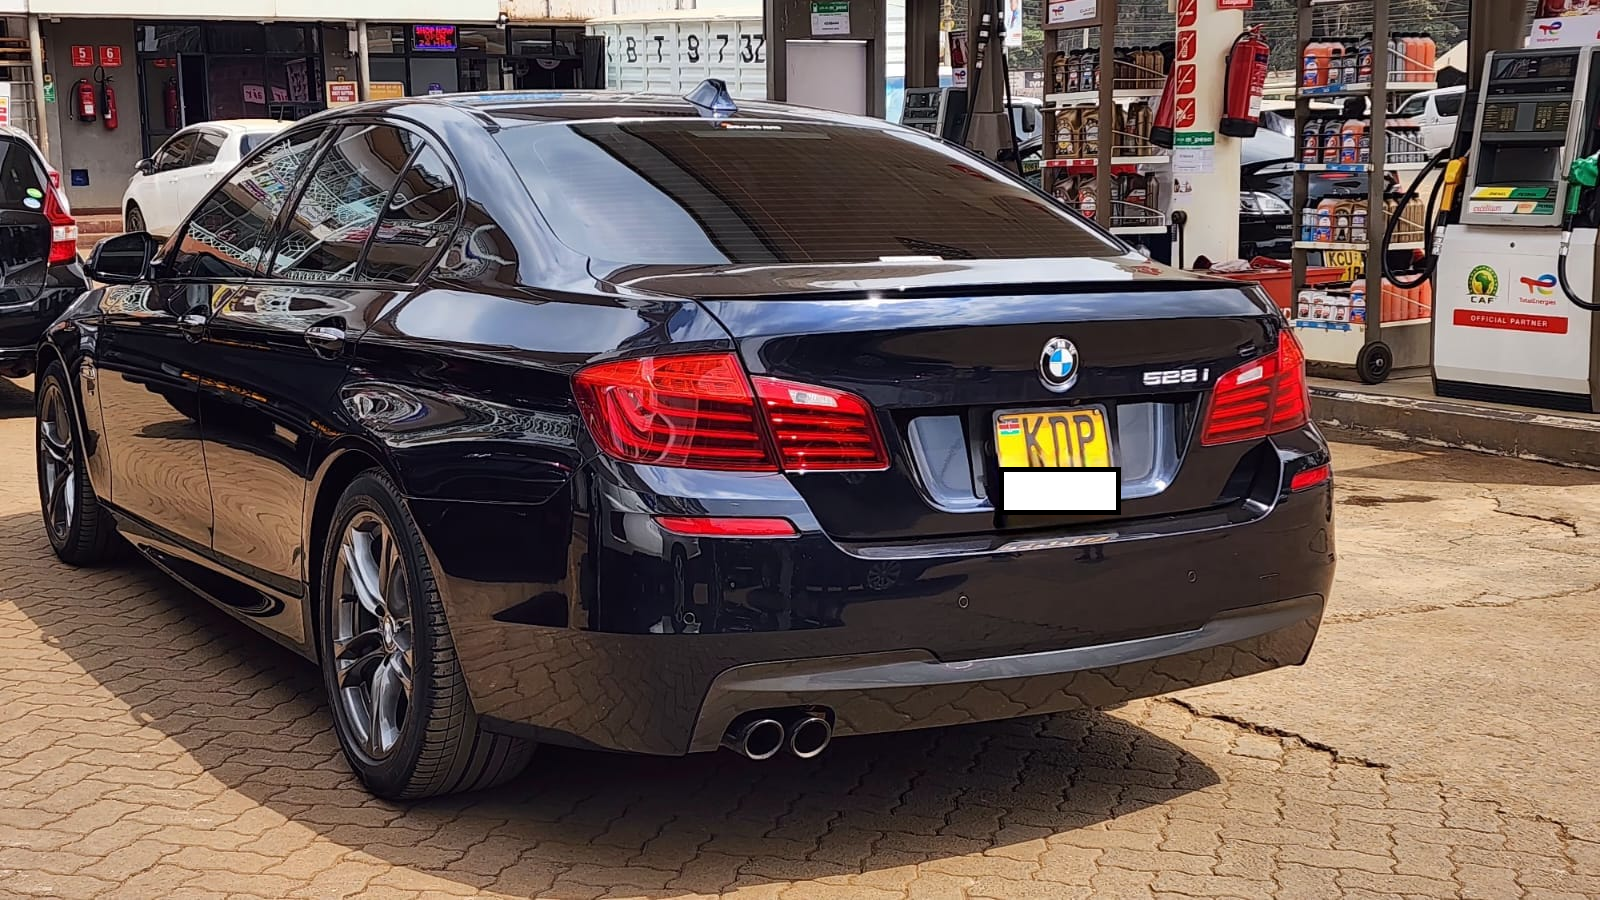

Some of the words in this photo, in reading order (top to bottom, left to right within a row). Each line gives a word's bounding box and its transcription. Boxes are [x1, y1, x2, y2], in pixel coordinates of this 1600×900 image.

[78, 47, 87, 59] 5
[106, 47, 114, 59] 6
[1328, 251, 1354, 267] KCU
[1470, 296, 1495, 304] CAF
[1519, 297, 1557, 306] TotalEnergies
[1470, 315, 1507, 325] OFFICIAL
[1509, 318, 1549, 328] PARTNER
